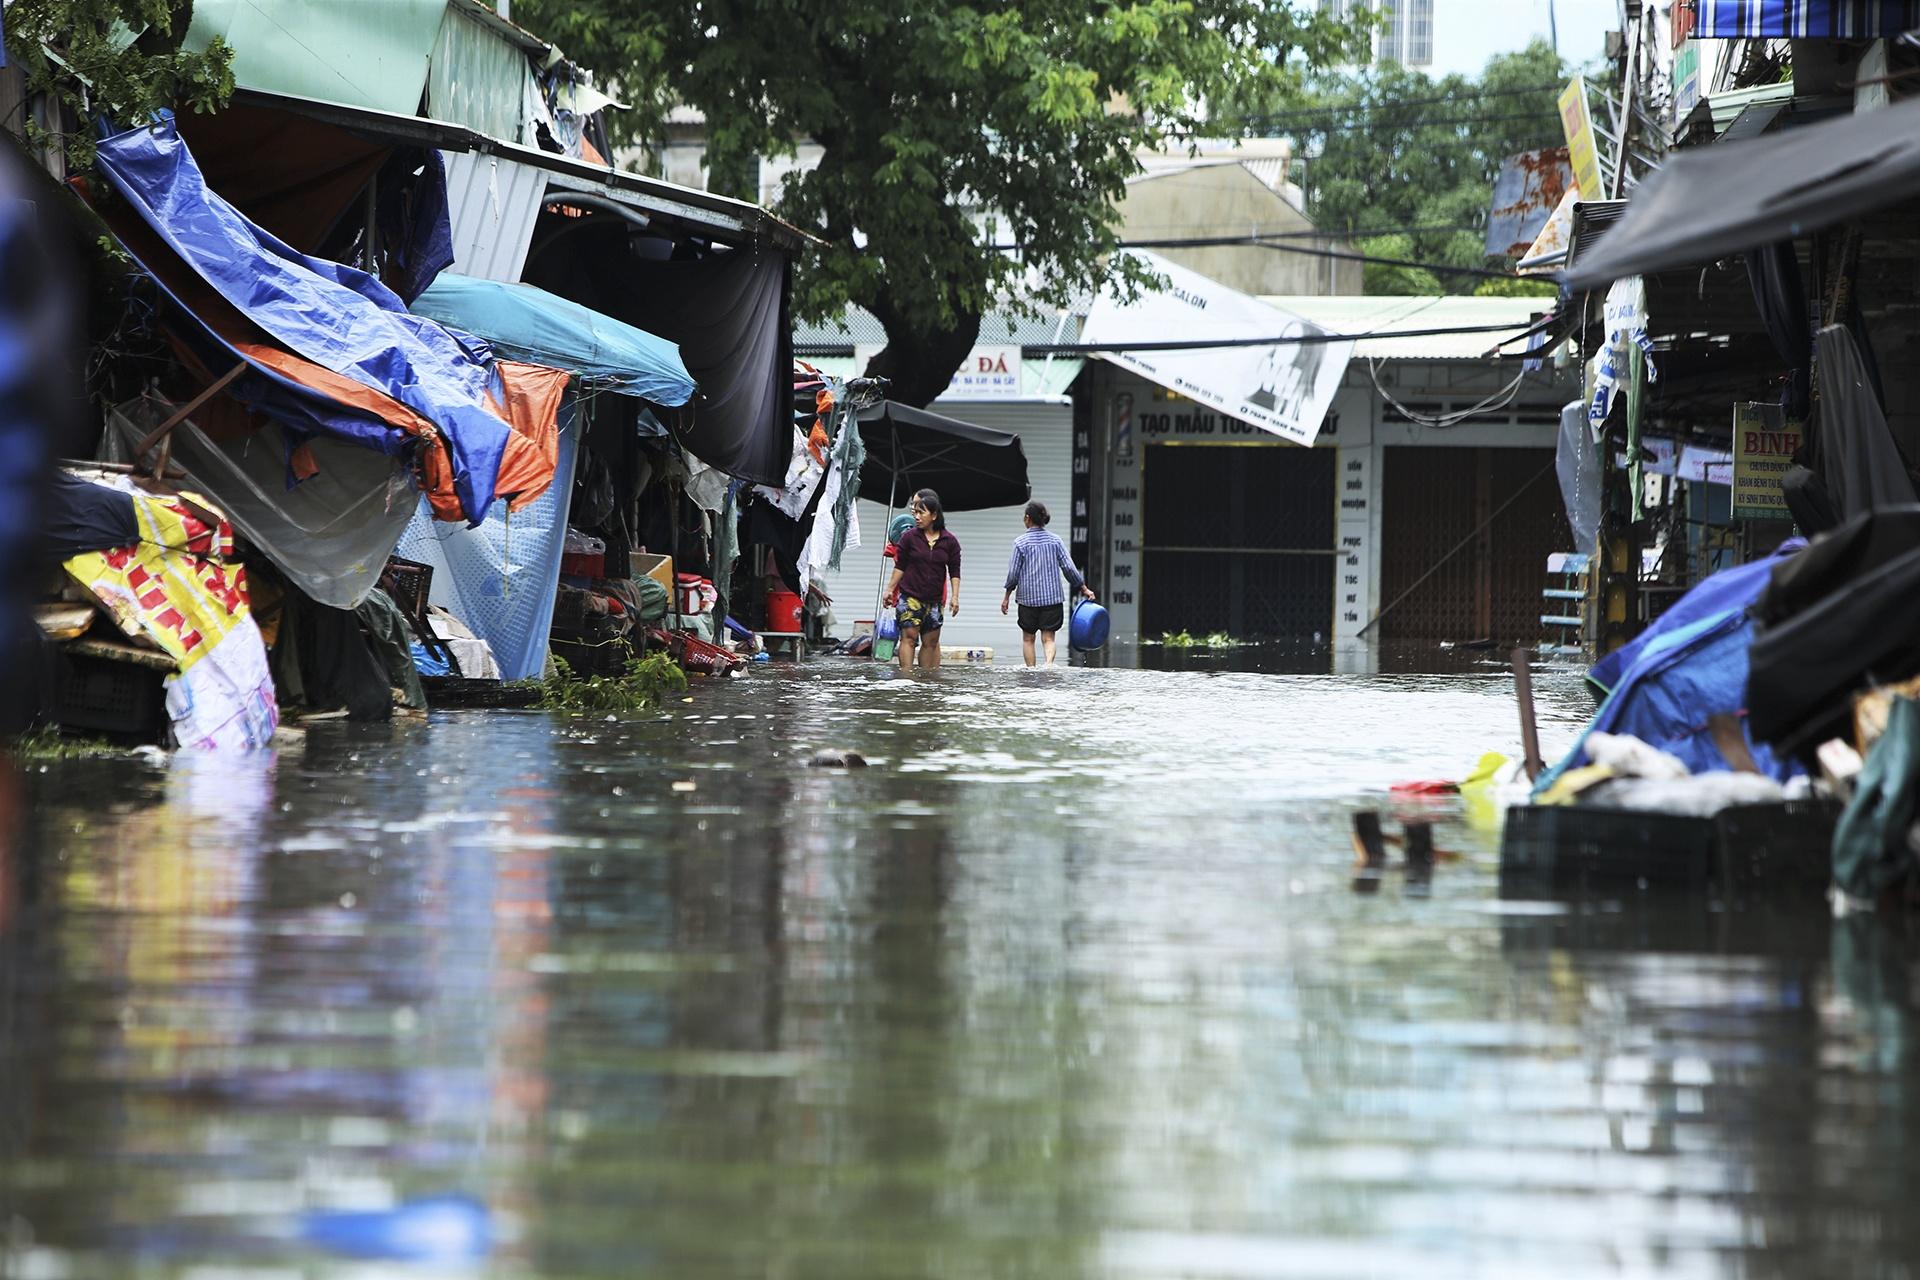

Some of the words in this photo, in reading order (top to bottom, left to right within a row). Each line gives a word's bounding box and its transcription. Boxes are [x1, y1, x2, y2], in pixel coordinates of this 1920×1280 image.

[1171, 287, 1208, 310] SALON
[978, 353, 1008, 372] ĐÁ
[1139, 413, 1170, 437] TẠO
[1175, 406, 1215, 434] MẪU
[1744, 425, 1800, 457] BÌNH
[1112, 488, 1137, 503] NHẬN
[1072, 526, 1088, 543] XAY
[1114, 540, 1133, 554] TẠO
[1343, 536, 1362, 549] PHỤC
[1114, 565, 1132, 580] HỌC
[1345, 574, 1358, 585] TÓC
[1113, 591, 1133, 604] VIÊN
